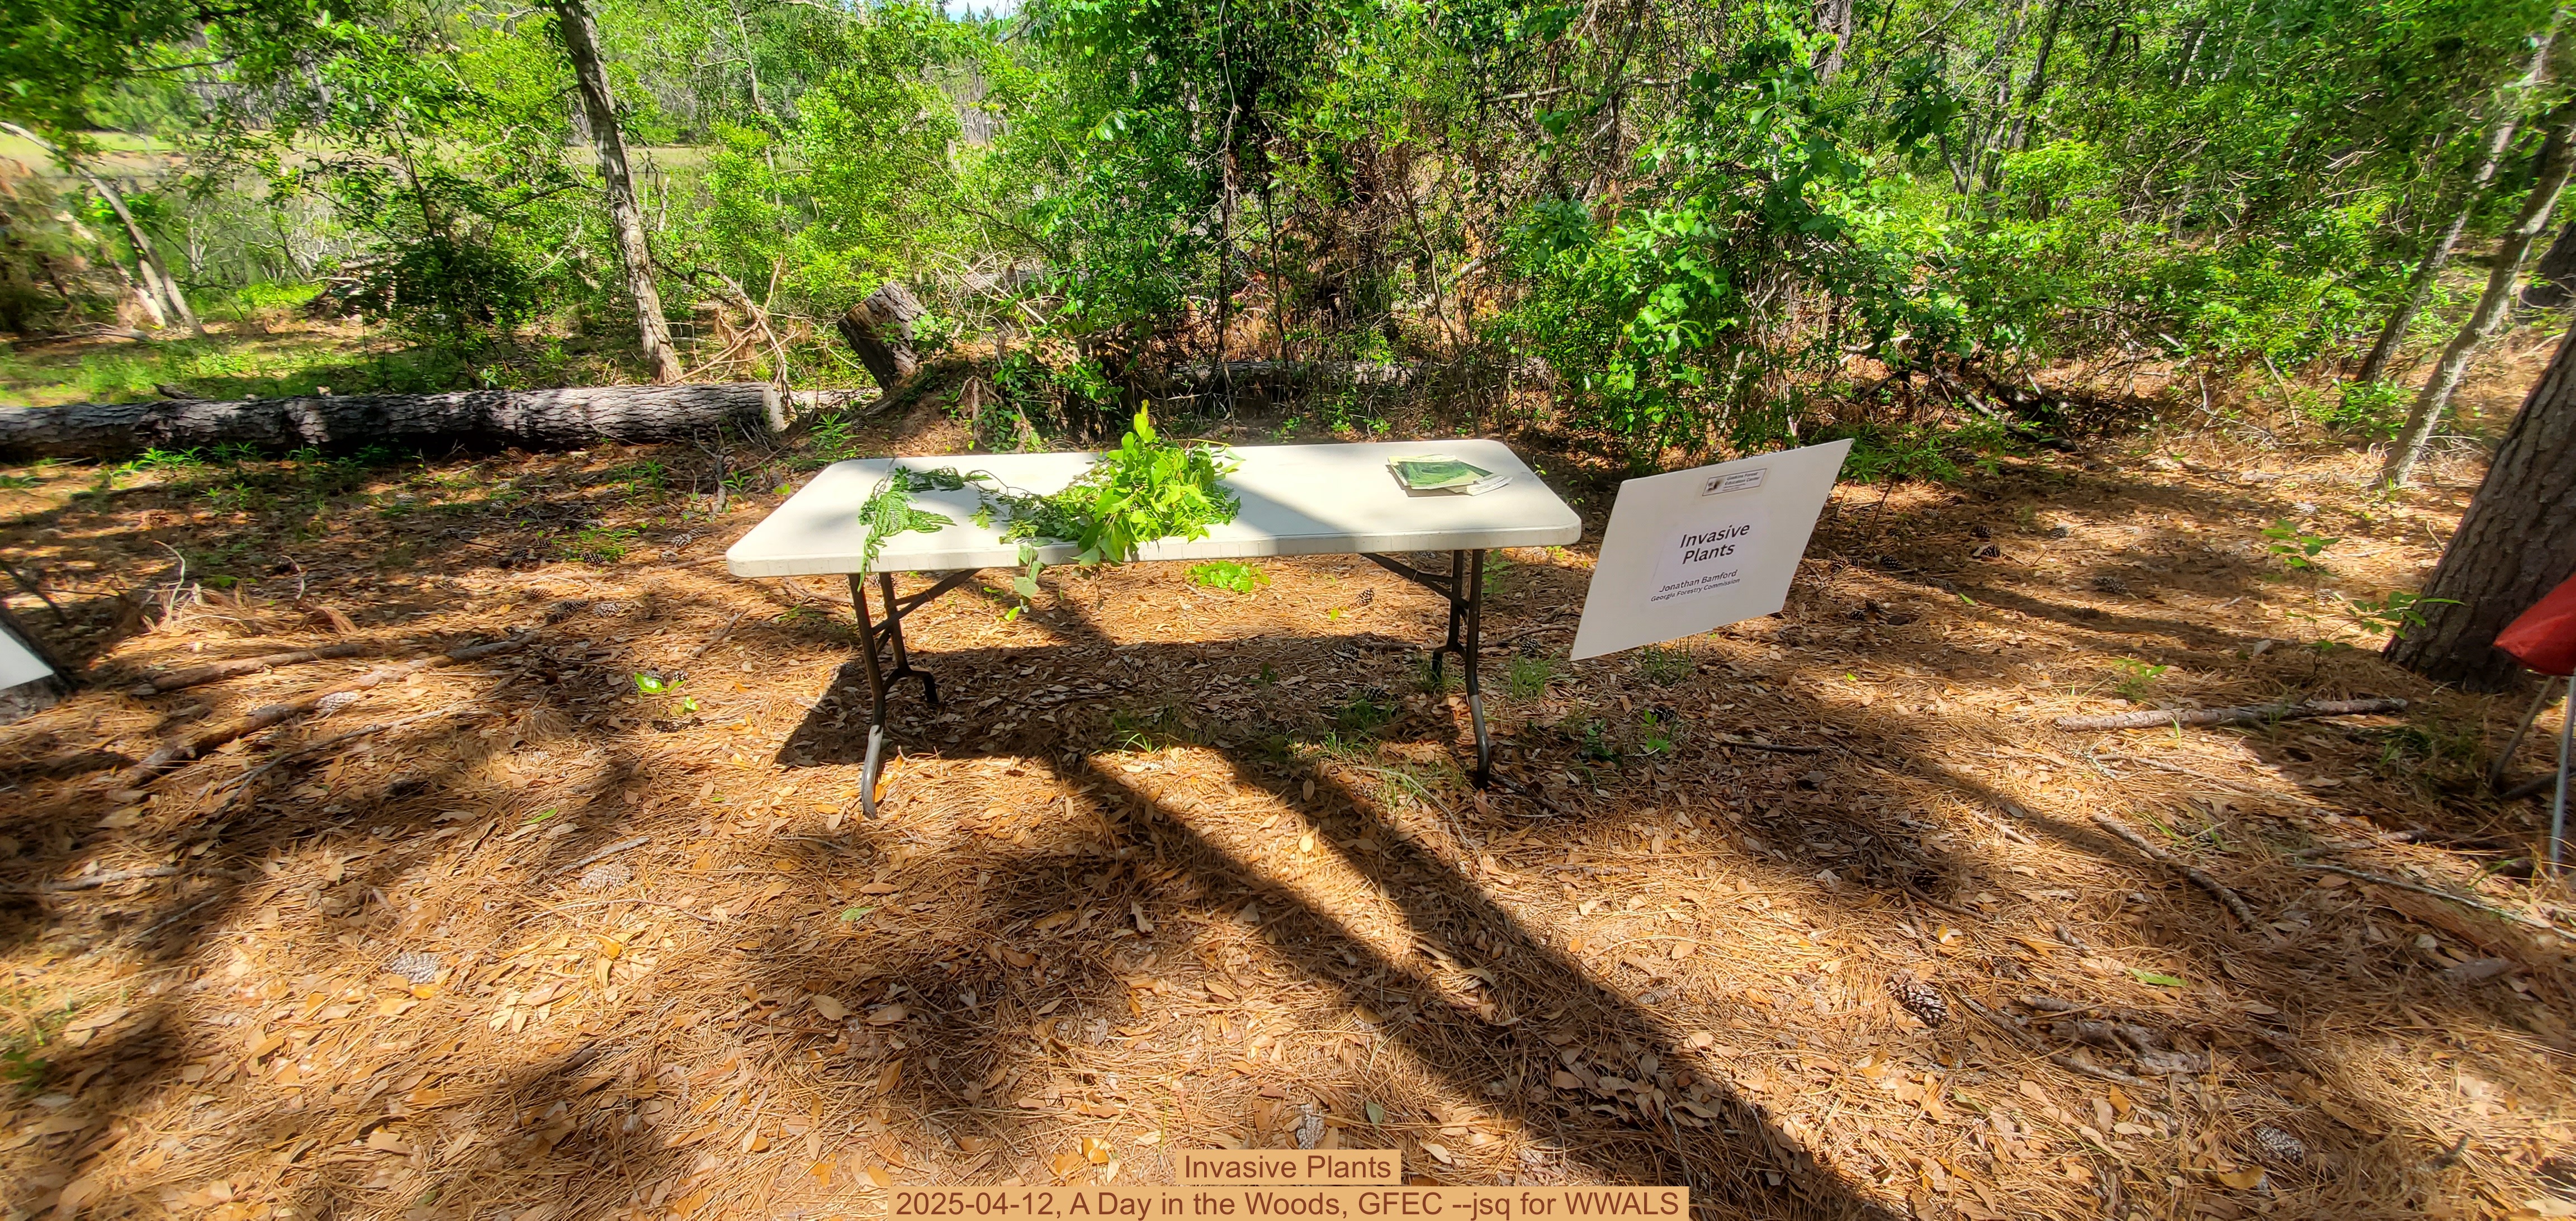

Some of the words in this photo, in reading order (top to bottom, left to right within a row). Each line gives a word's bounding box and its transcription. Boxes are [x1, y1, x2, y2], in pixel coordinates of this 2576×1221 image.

[1679, 524, 1750, 548] Invasive
[1682, 543, 1736, 565] Plants
[1650, 593, 1675, 602] Georgia
[1676, 587, 1703, 597] Forestry
[1703, 578, 1741, 591] Commission
[1659, 580, 1700, 593] Jonathan
[1701, 569, 1738, 584] Bamford
